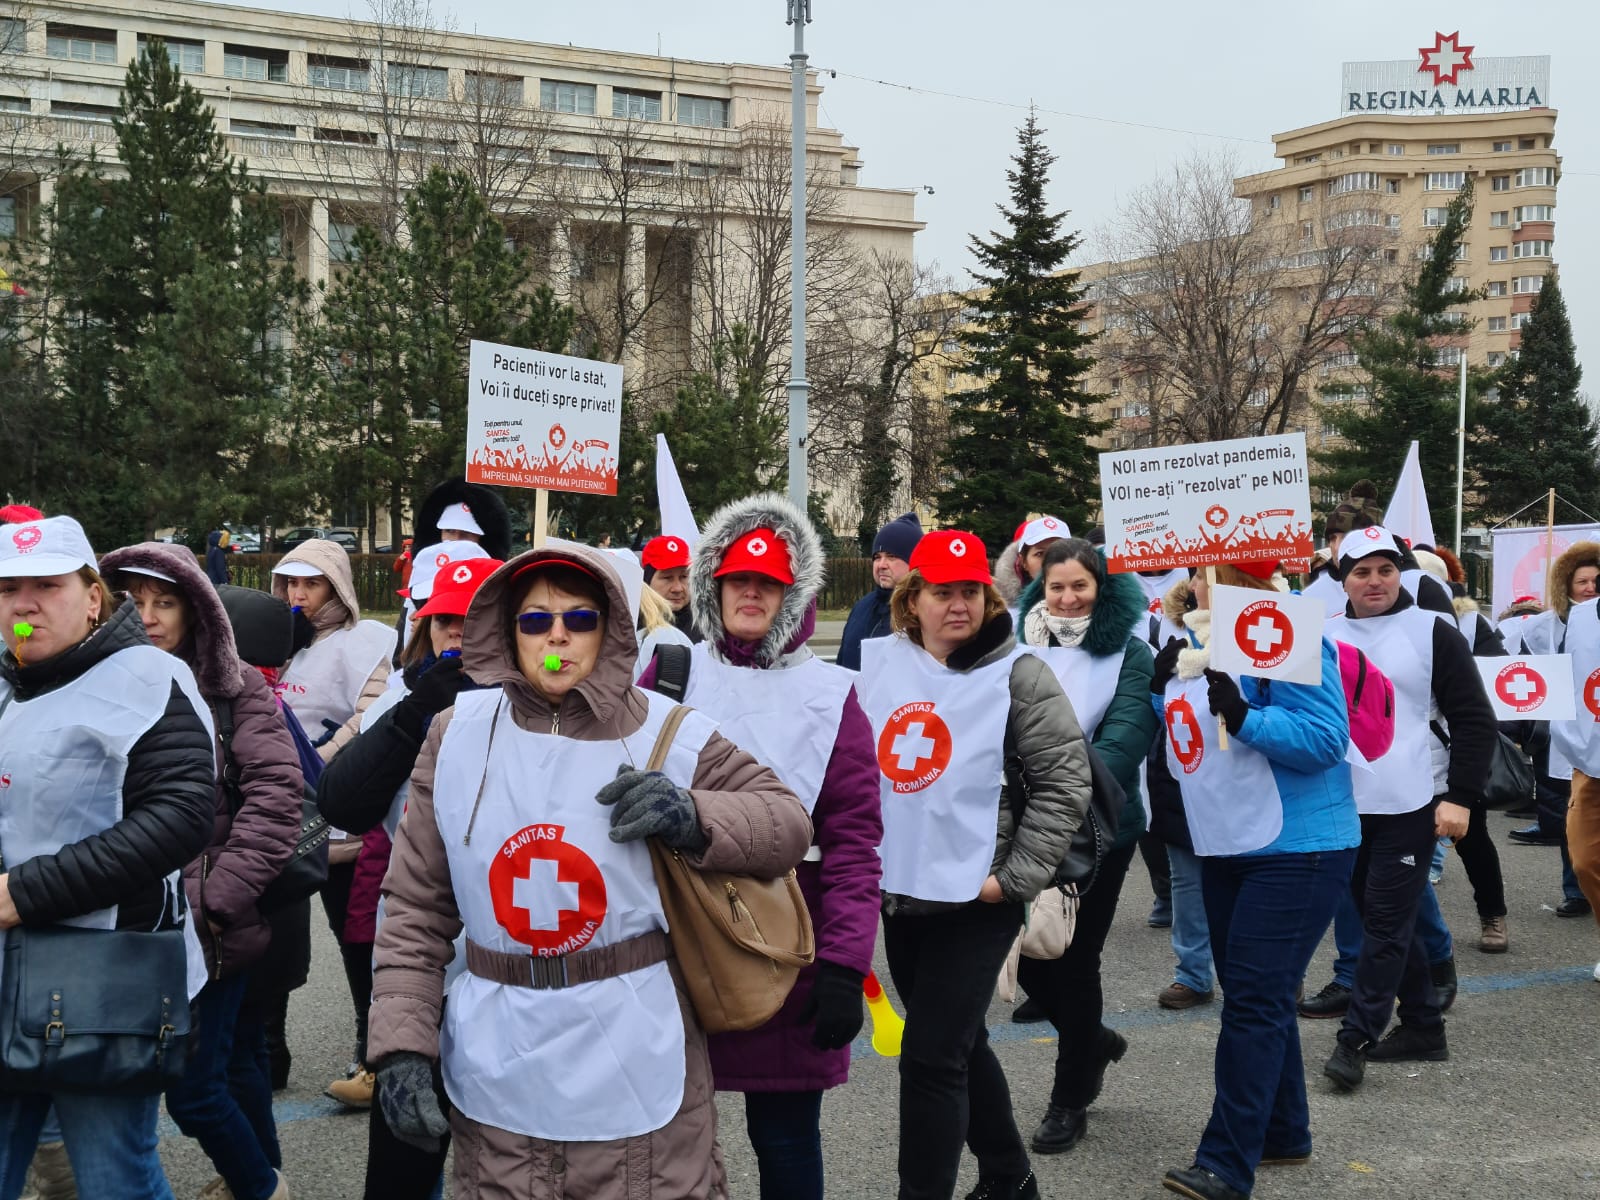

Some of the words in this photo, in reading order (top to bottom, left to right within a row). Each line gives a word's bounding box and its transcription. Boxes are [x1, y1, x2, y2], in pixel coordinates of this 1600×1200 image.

[1349, 90, 1446, 110] REGINA
[1454, 86, 1542, 107] MARIA
[548, 366, 567, 379] vor
[570, 366, 580, 382] la
[583, 370, 607, 388] stat,
[480, 379, 499, 397] Voi
[502, 381, 510, 398] îi
[552, 393, 578, 410] spre
[580, 395, 616, 413] privat!
[1112, 459, 1136, 475] NOI
[1140, 459, 1161, 473] am
[1164, 451, 1219, 470] rezolvat
[1223, 443, 1296, 468] pandemia,
[481, 468, 523, 483] ÎMPREUNĂ
[524, 475, 555, 486] SUNTEM
[556, 477, 570, 487] MAI
[570, 478, 607, 491] PUTERNICI
[1108, 485, 1131, 501] VOI
[1252, 473, 1269, 491] pe
[1272, 468, 1303, 485] NOI!
[1125, 520, 1155, 532] SANITAS
[1133, 513, 1154, 523] pentru
[1124, 557, 1176, 569] ÎMPREUNĂ
[1178, 554, 1220, 565] SUNTEM
[1222, 552, 1240, 561] MAI
[1242, 547, 1297, 559] PUTERNICI
[1243, 600, 1274, 617] SANITAS
[892, 703, 932, 723] SANITAS
[503, 827, 557, 859] SANITAS
[538, 919, 599, 959] ROMÂNIA
